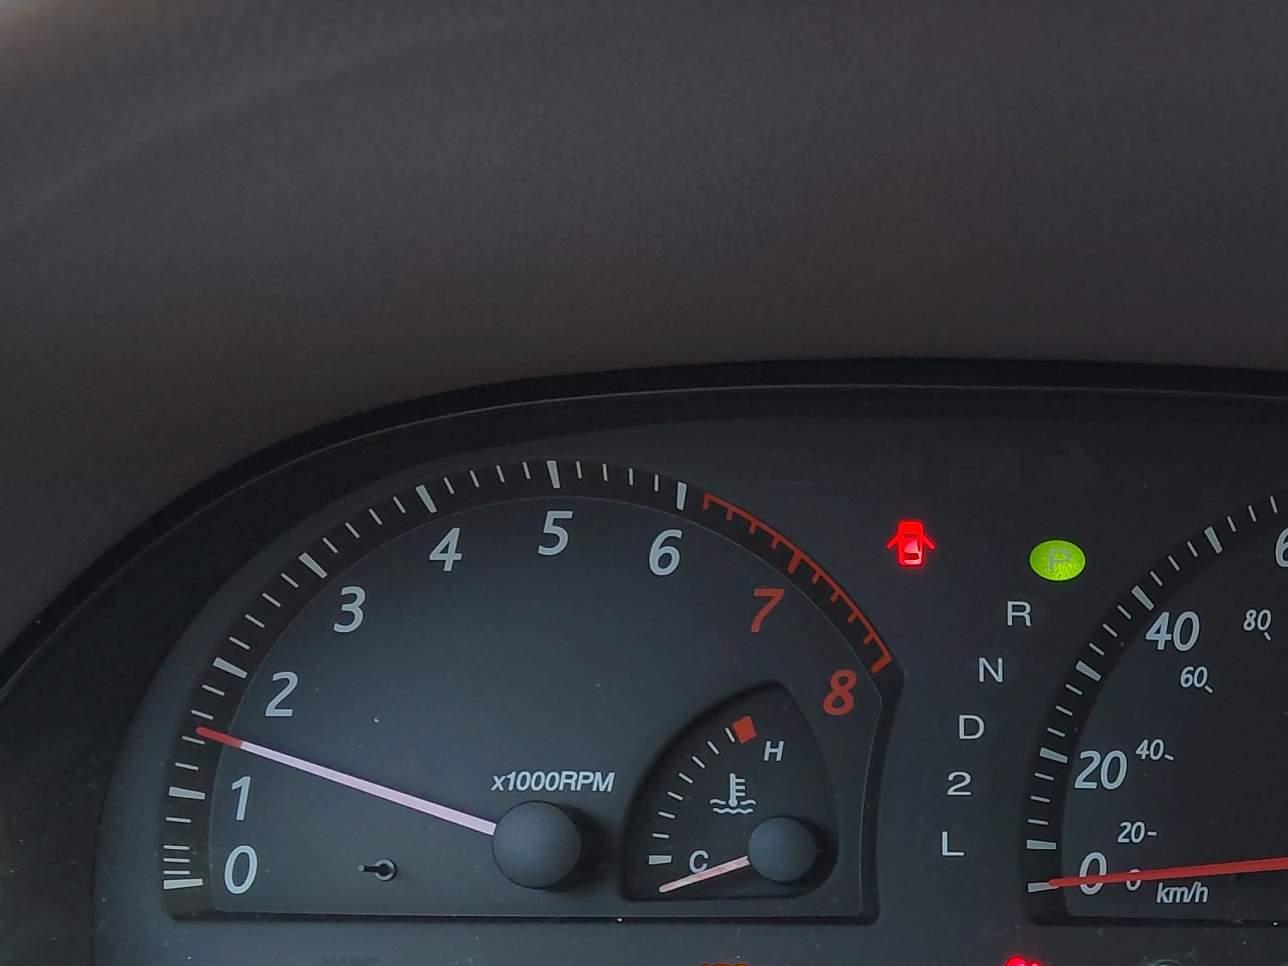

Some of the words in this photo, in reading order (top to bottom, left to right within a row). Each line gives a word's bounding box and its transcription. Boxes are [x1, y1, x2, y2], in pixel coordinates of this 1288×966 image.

[538, 511, 573, 555] 5
[429, 528, 462, 571] 4
[649, 529, 682, 575] 6
[1048, 549, 1071, 571] P
[334, 586, 365, 632] 3
[752, 588, 784, 632] 7
[1008, 601, 1031, 626] R
[1146, 612, 1199, 651] 40
[1244, 610, 1271, 634] 80
[979, 658, 1002, 682] N
[1181, 666, 1207, 689] 60
[265, 672, 298, 716] 2
[823, 670, 856, 715] 8
[959, 715, 984, 739] D
[764, 741, 784, 761] H
[1136, 739, 1165, 760] 40
[491, 771, 615, 792] x1000RPM
[1075, 751, 1127, 789] 20
[947, 772, 971, 795] 2
[232, 776, 251, 820] 1
[942, 831, 964, 856] L
[1118, 822, 1145, 843] 20
[225, 846, 257, 894] 0
[690, 850, 709, 871] C
[1078, 852, 1108, 894] 0
[1157, 882, 1208, 903] km/h
